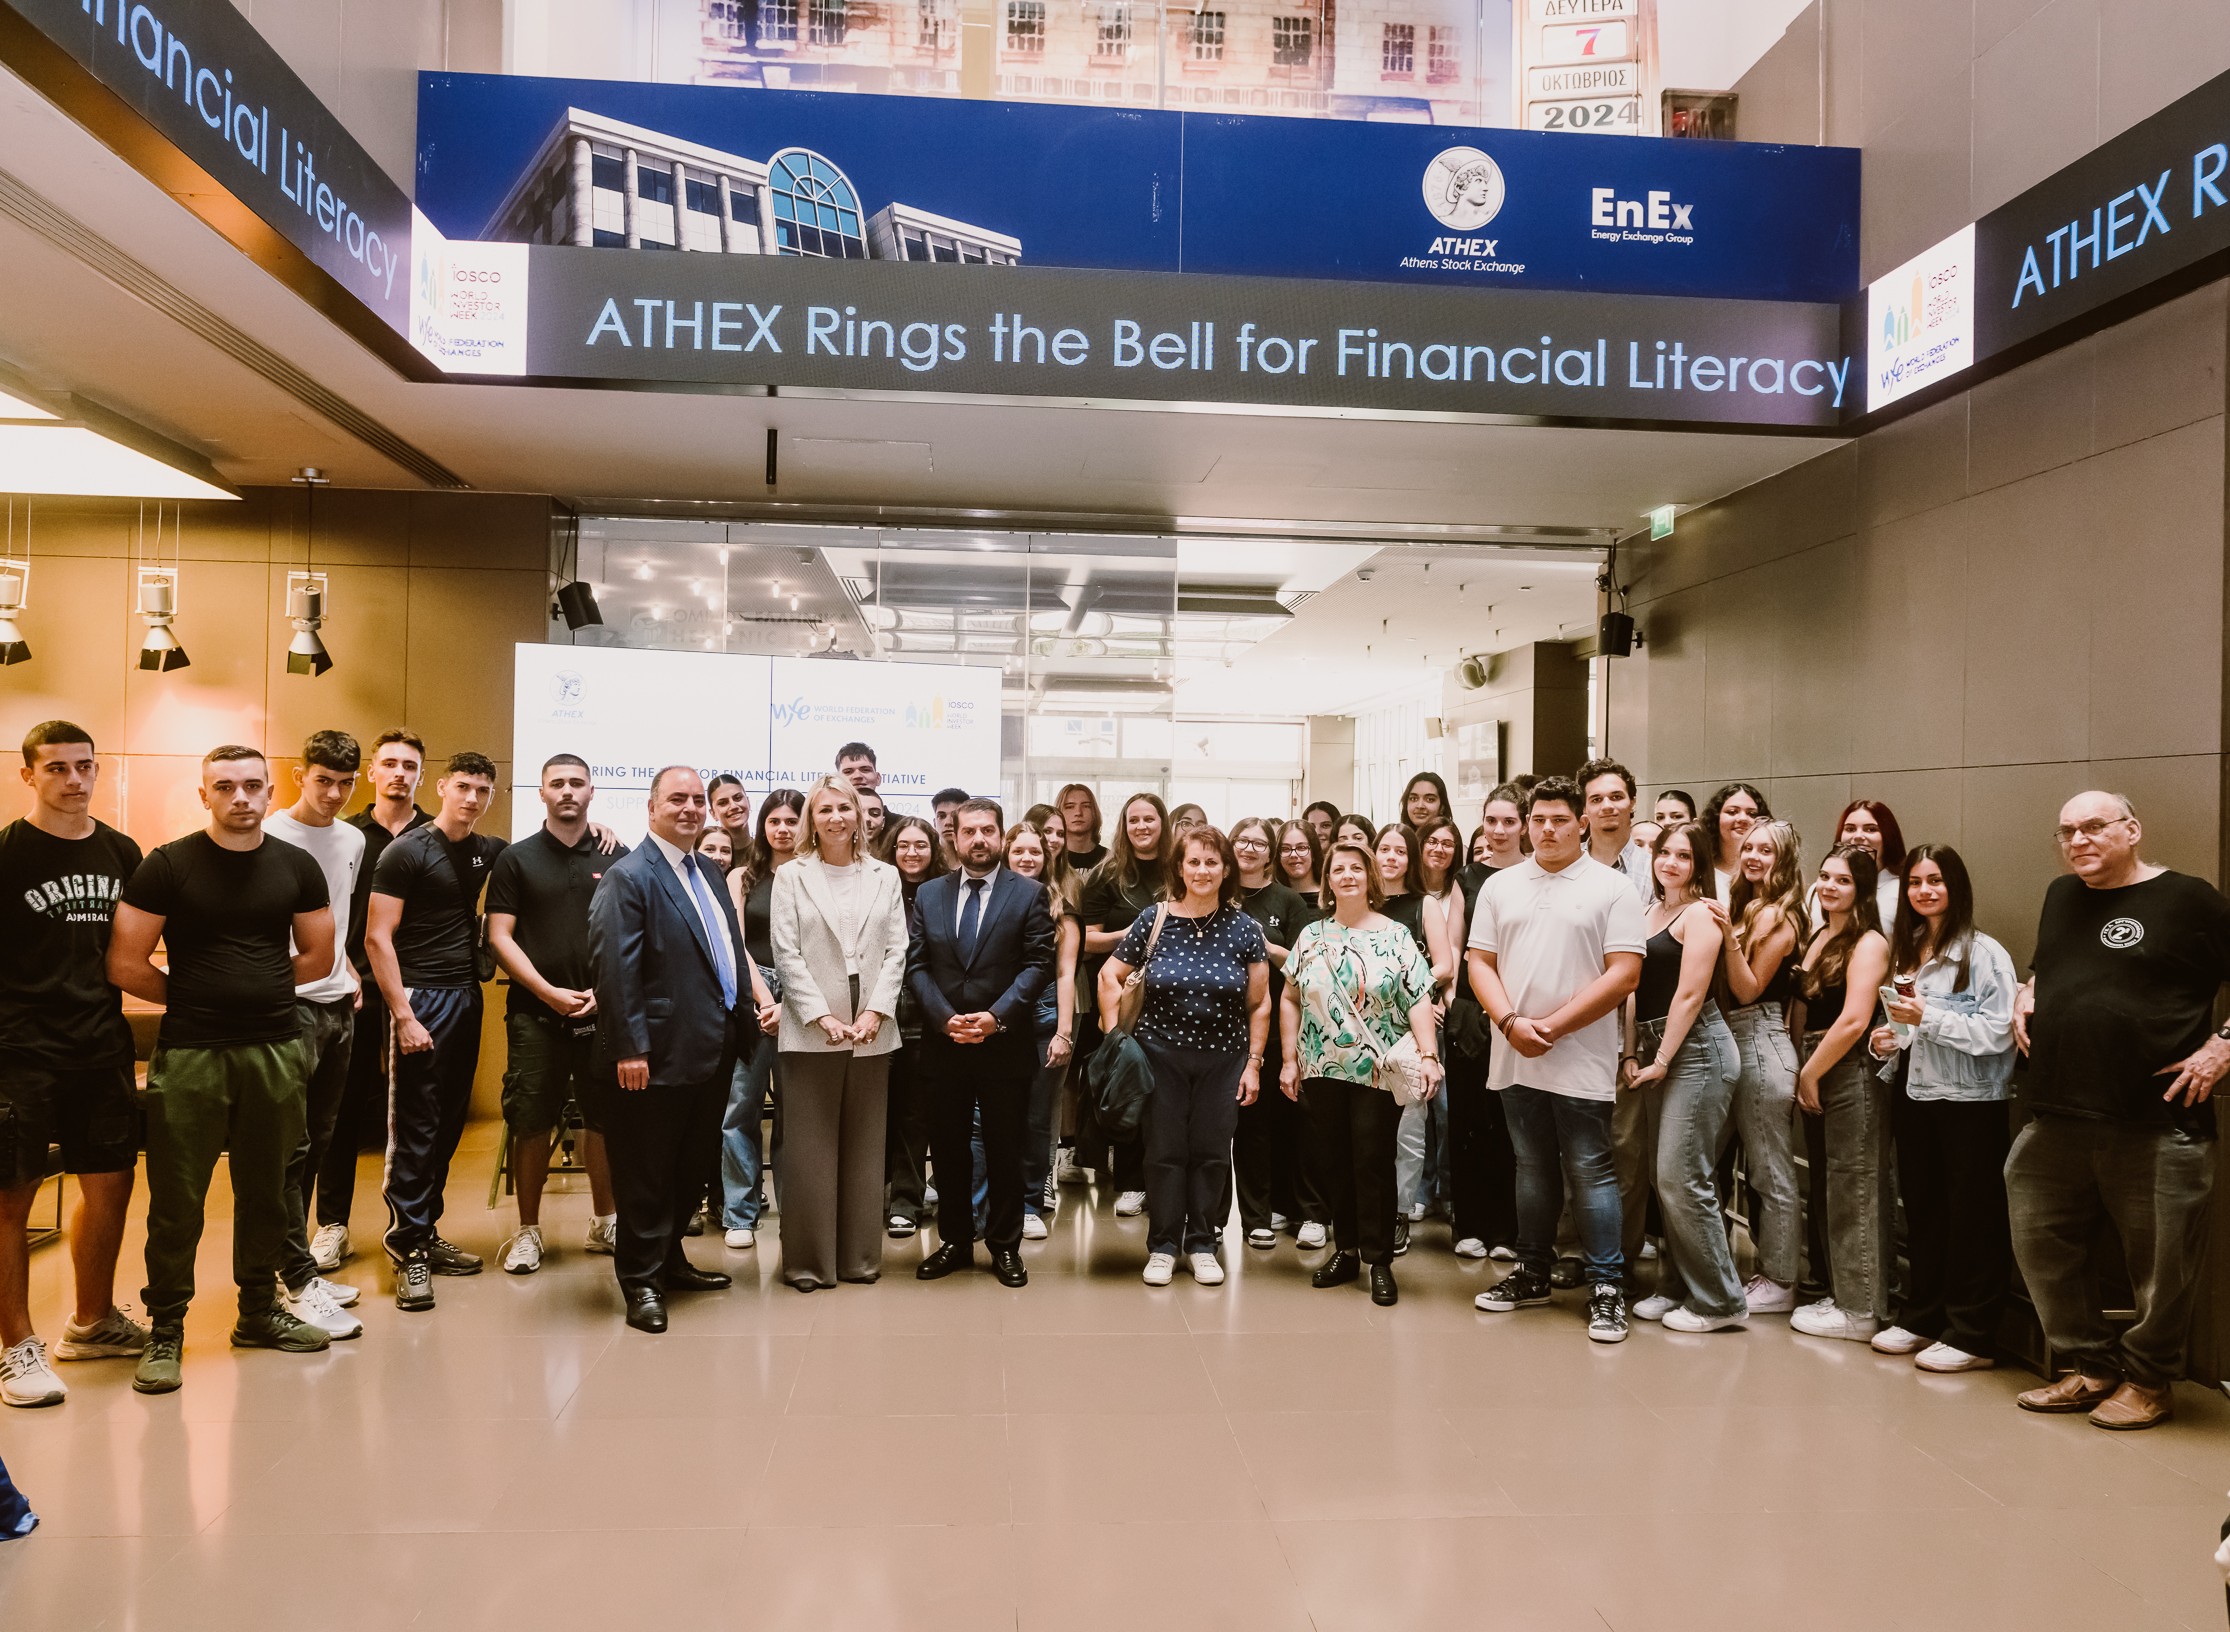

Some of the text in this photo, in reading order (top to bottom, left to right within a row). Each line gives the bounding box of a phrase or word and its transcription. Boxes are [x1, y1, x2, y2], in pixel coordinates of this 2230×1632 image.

[1575, 28, 1601, 56] 7
[1542, 69, 1627, 91] ΟΚΤΩΒΡΙΟΣ
[1544, 101, 1641, 129] 2024
[280, 128, 398, 300] Literacy
[1592, 188, 1694, 230] EnEx
[1428, 236, 1498, 257] ATHEX
[1591, 229, 1694, 246] Energy Exchange Group
[2012, 169, 2171, 309] ATHEX
[1400, 256, 1526, 275] Athens Stock Exchange
[586, 297, 1850, 408] ATHEX Rings the Bell for Financial Literacy
[551, 709, 585, 719] ATHEX
[814, 705, 844, 714] WORLD
[846, 706, 896, 716] FEDERATION
[814, 714, 876, 724] OF EXCHANGES
[592, 766, 627, 778] RING
[632, 767, 655, 778] THE
[696, 769, 719, 780] OR
[881, 773, 926, 785] TIATIVE
